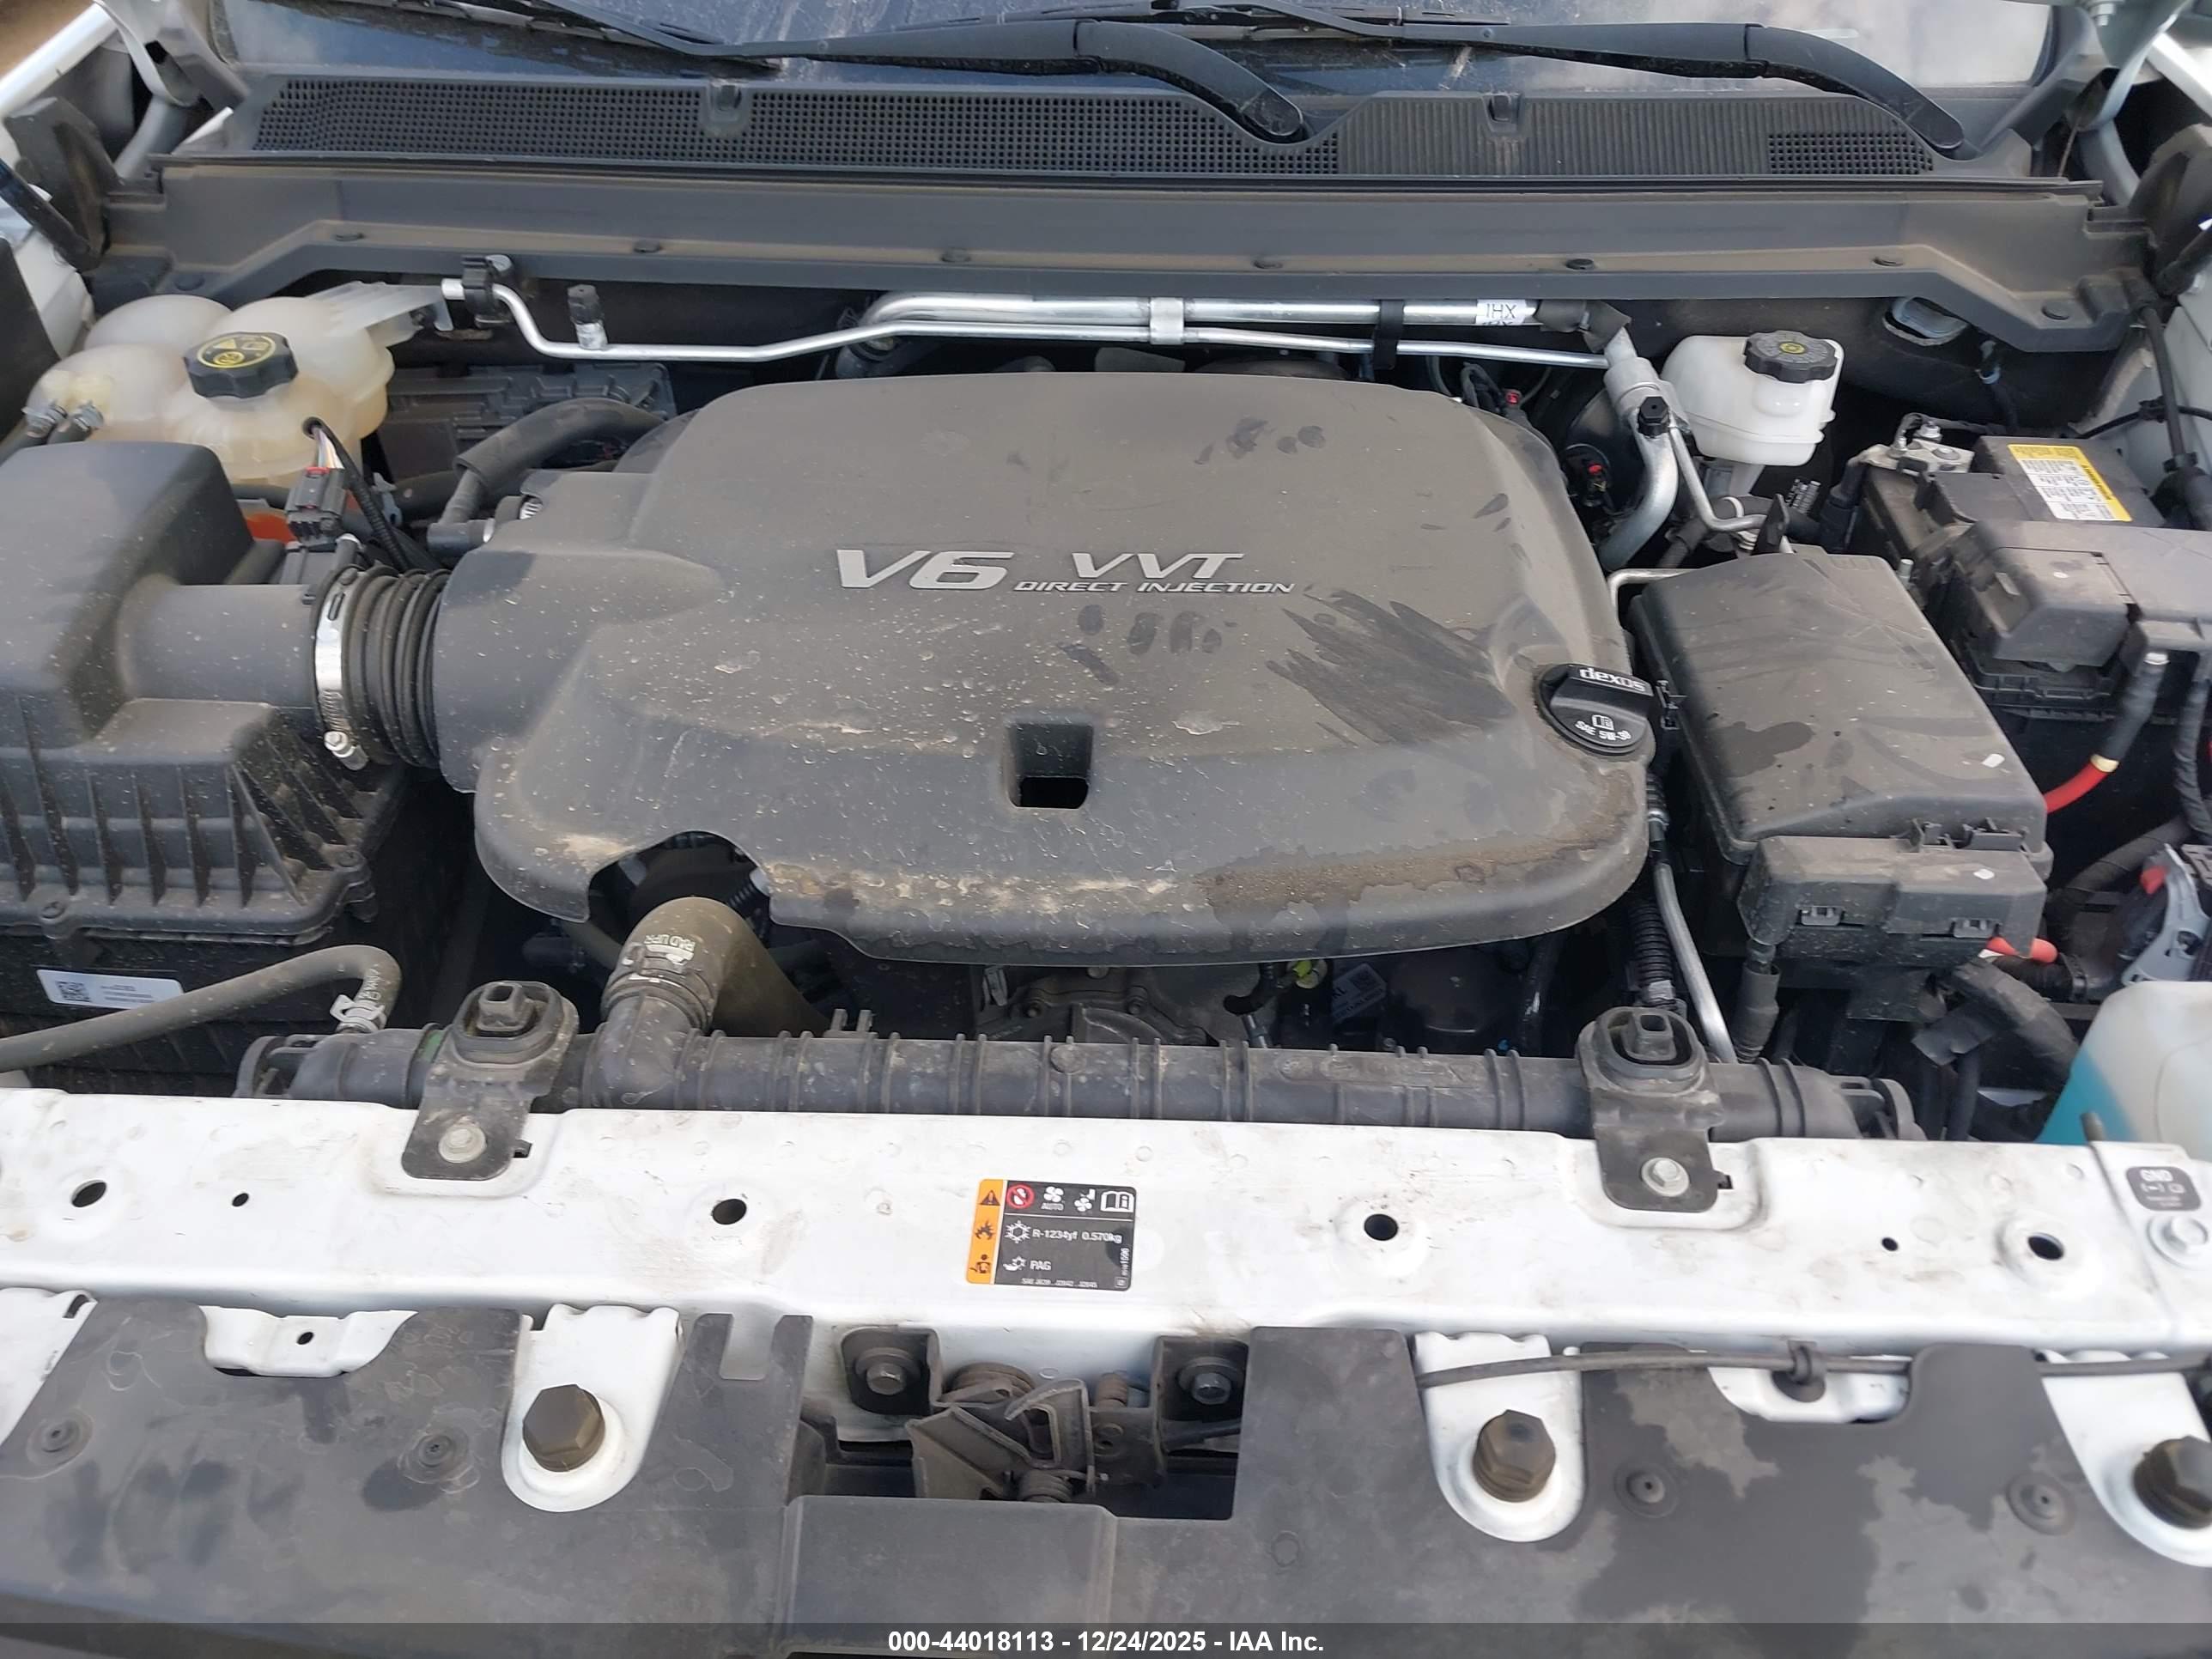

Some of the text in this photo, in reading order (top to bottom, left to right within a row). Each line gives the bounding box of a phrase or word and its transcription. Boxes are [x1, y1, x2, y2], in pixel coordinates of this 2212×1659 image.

[836, 549, 1015, 590] V6
[1072, 552, 1244, 580] VVT
[1014, 580, 1296, 594] DIRECT INJECTION
[1579, 667, 1647, 692] dexos
[1030, 1260, 1052, 1271] PAG
